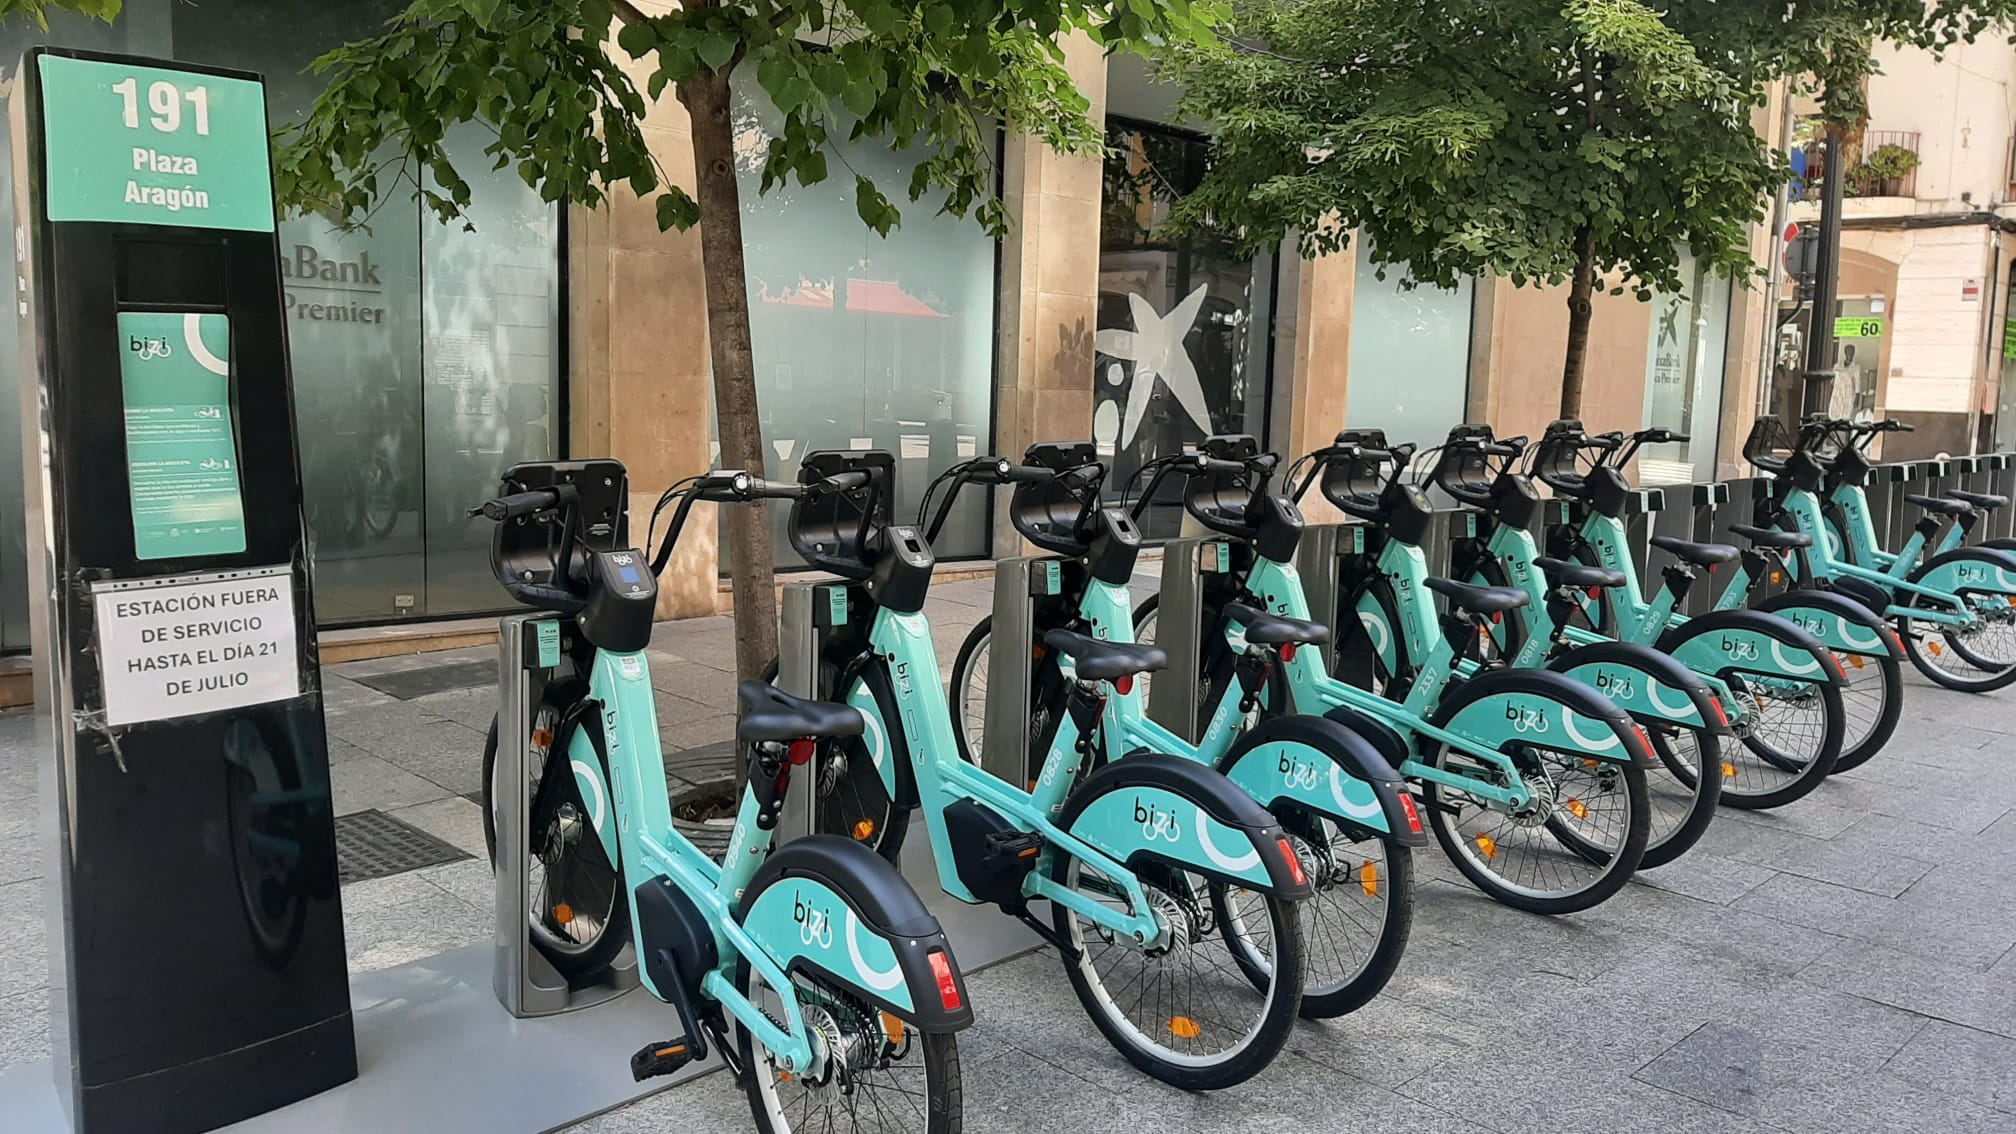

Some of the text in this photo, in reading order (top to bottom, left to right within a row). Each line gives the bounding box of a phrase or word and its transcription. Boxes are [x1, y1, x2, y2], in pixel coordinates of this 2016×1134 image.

[112, 77, 209, 136] 191
[132, 147, 198, 176] Plaza
[124, 180, 209, 212] Aragón
[1860, 321, 1879, 337] 60
[130, 334, 170, 358] bizi
[116, 587, 280, 618] ESTACIÓN FUERA
[141, 616, 262, 643] DE SERVICIO
[127, 641, 278, 673] HASTA EL DÍA 21
[1722, 634, 1758, 659] bizi
[166, 671, 249, 696] DE JULIO
[1597, 669, 1633, 698] bizi
[1506, 700, 1548, 730] bizi
[1042, 747, 1063, 786] 0828
[1279, 749, 1316, 788] bizi
[1134, 796, 1180, 840] bizi
[793, 889, 832, 947] bizi
